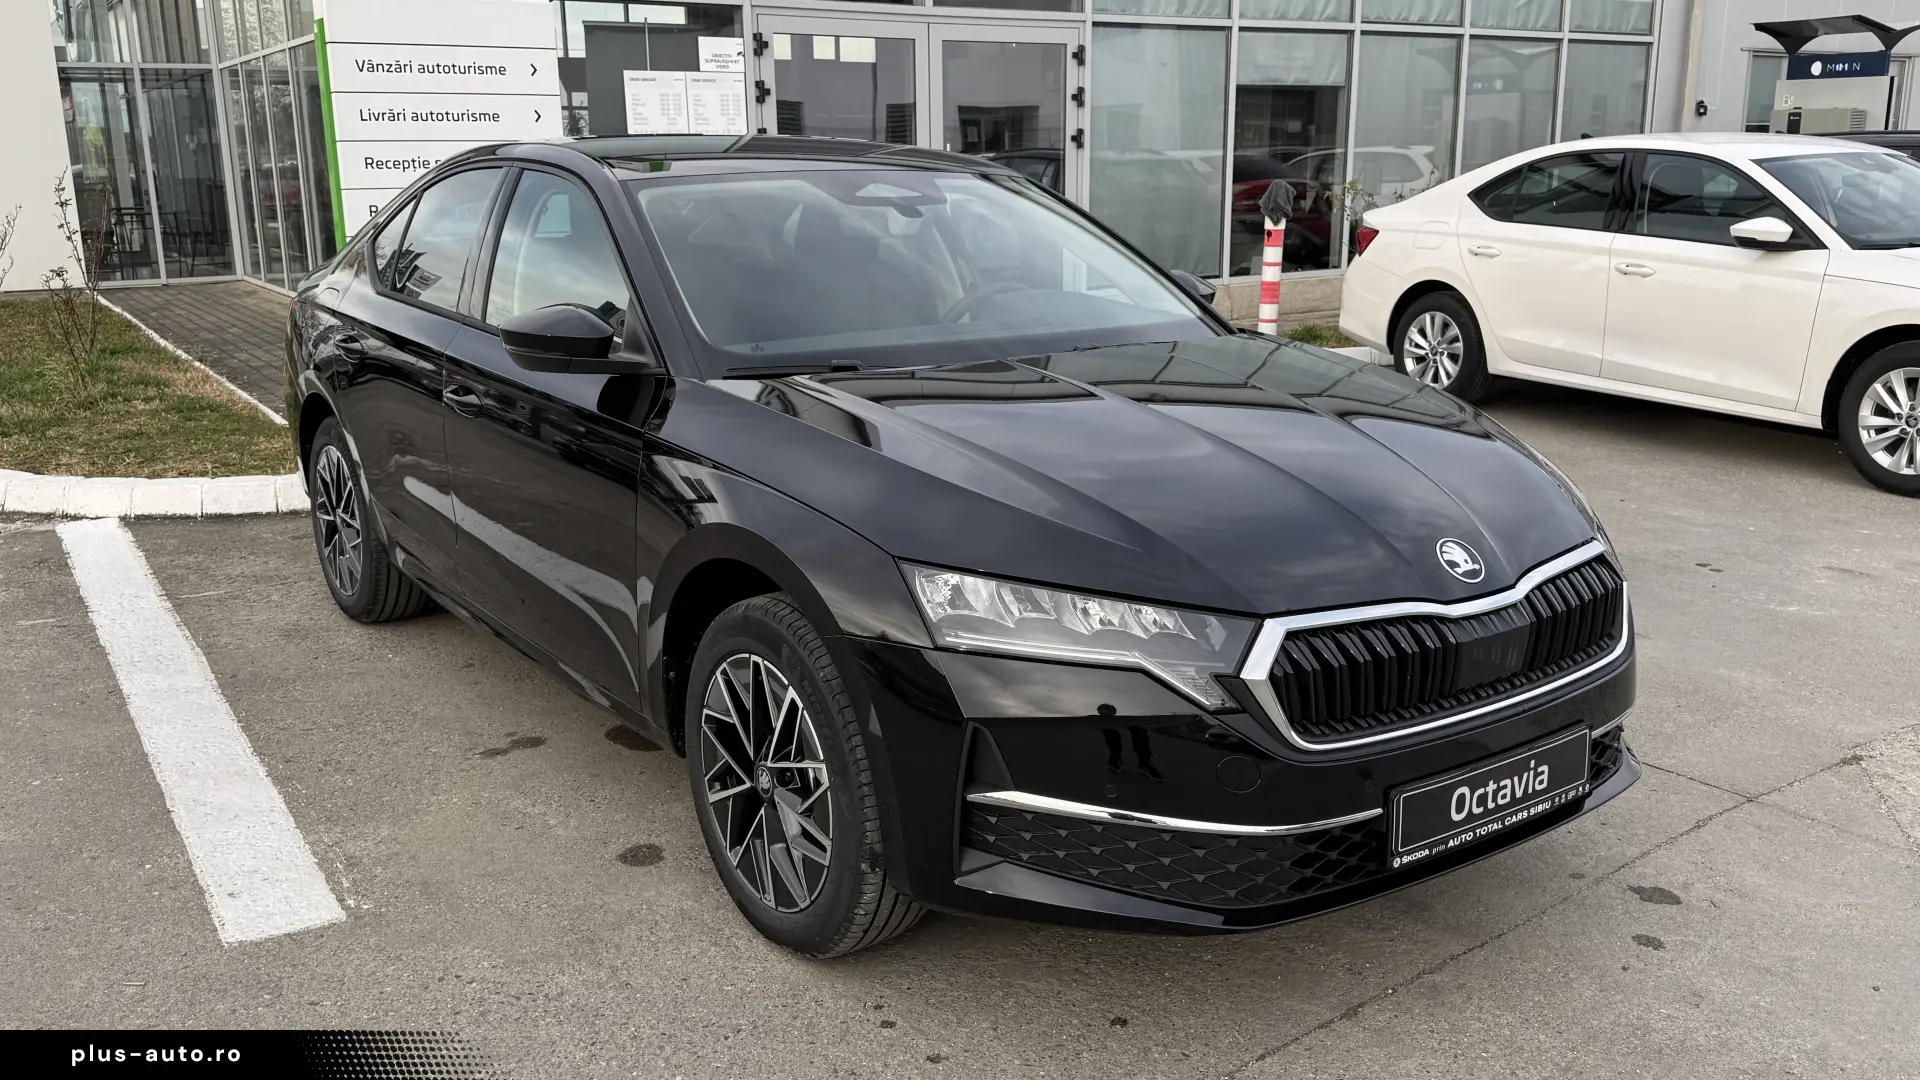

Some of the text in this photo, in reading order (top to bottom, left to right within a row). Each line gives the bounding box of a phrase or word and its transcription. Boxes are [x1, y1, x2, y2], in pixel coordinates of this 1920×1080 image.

[355, 59, 507, 76] Vânzări autoturisme
[359, 108, 500, 122] Livrări autoturisme
[364, 156, 430, 173] Recepție
[1450, 759, 1549, 821] Octavia
[1402, 800, 1551, 864] ŠKODA prin AUTO TOTAL CARS SIBIU
